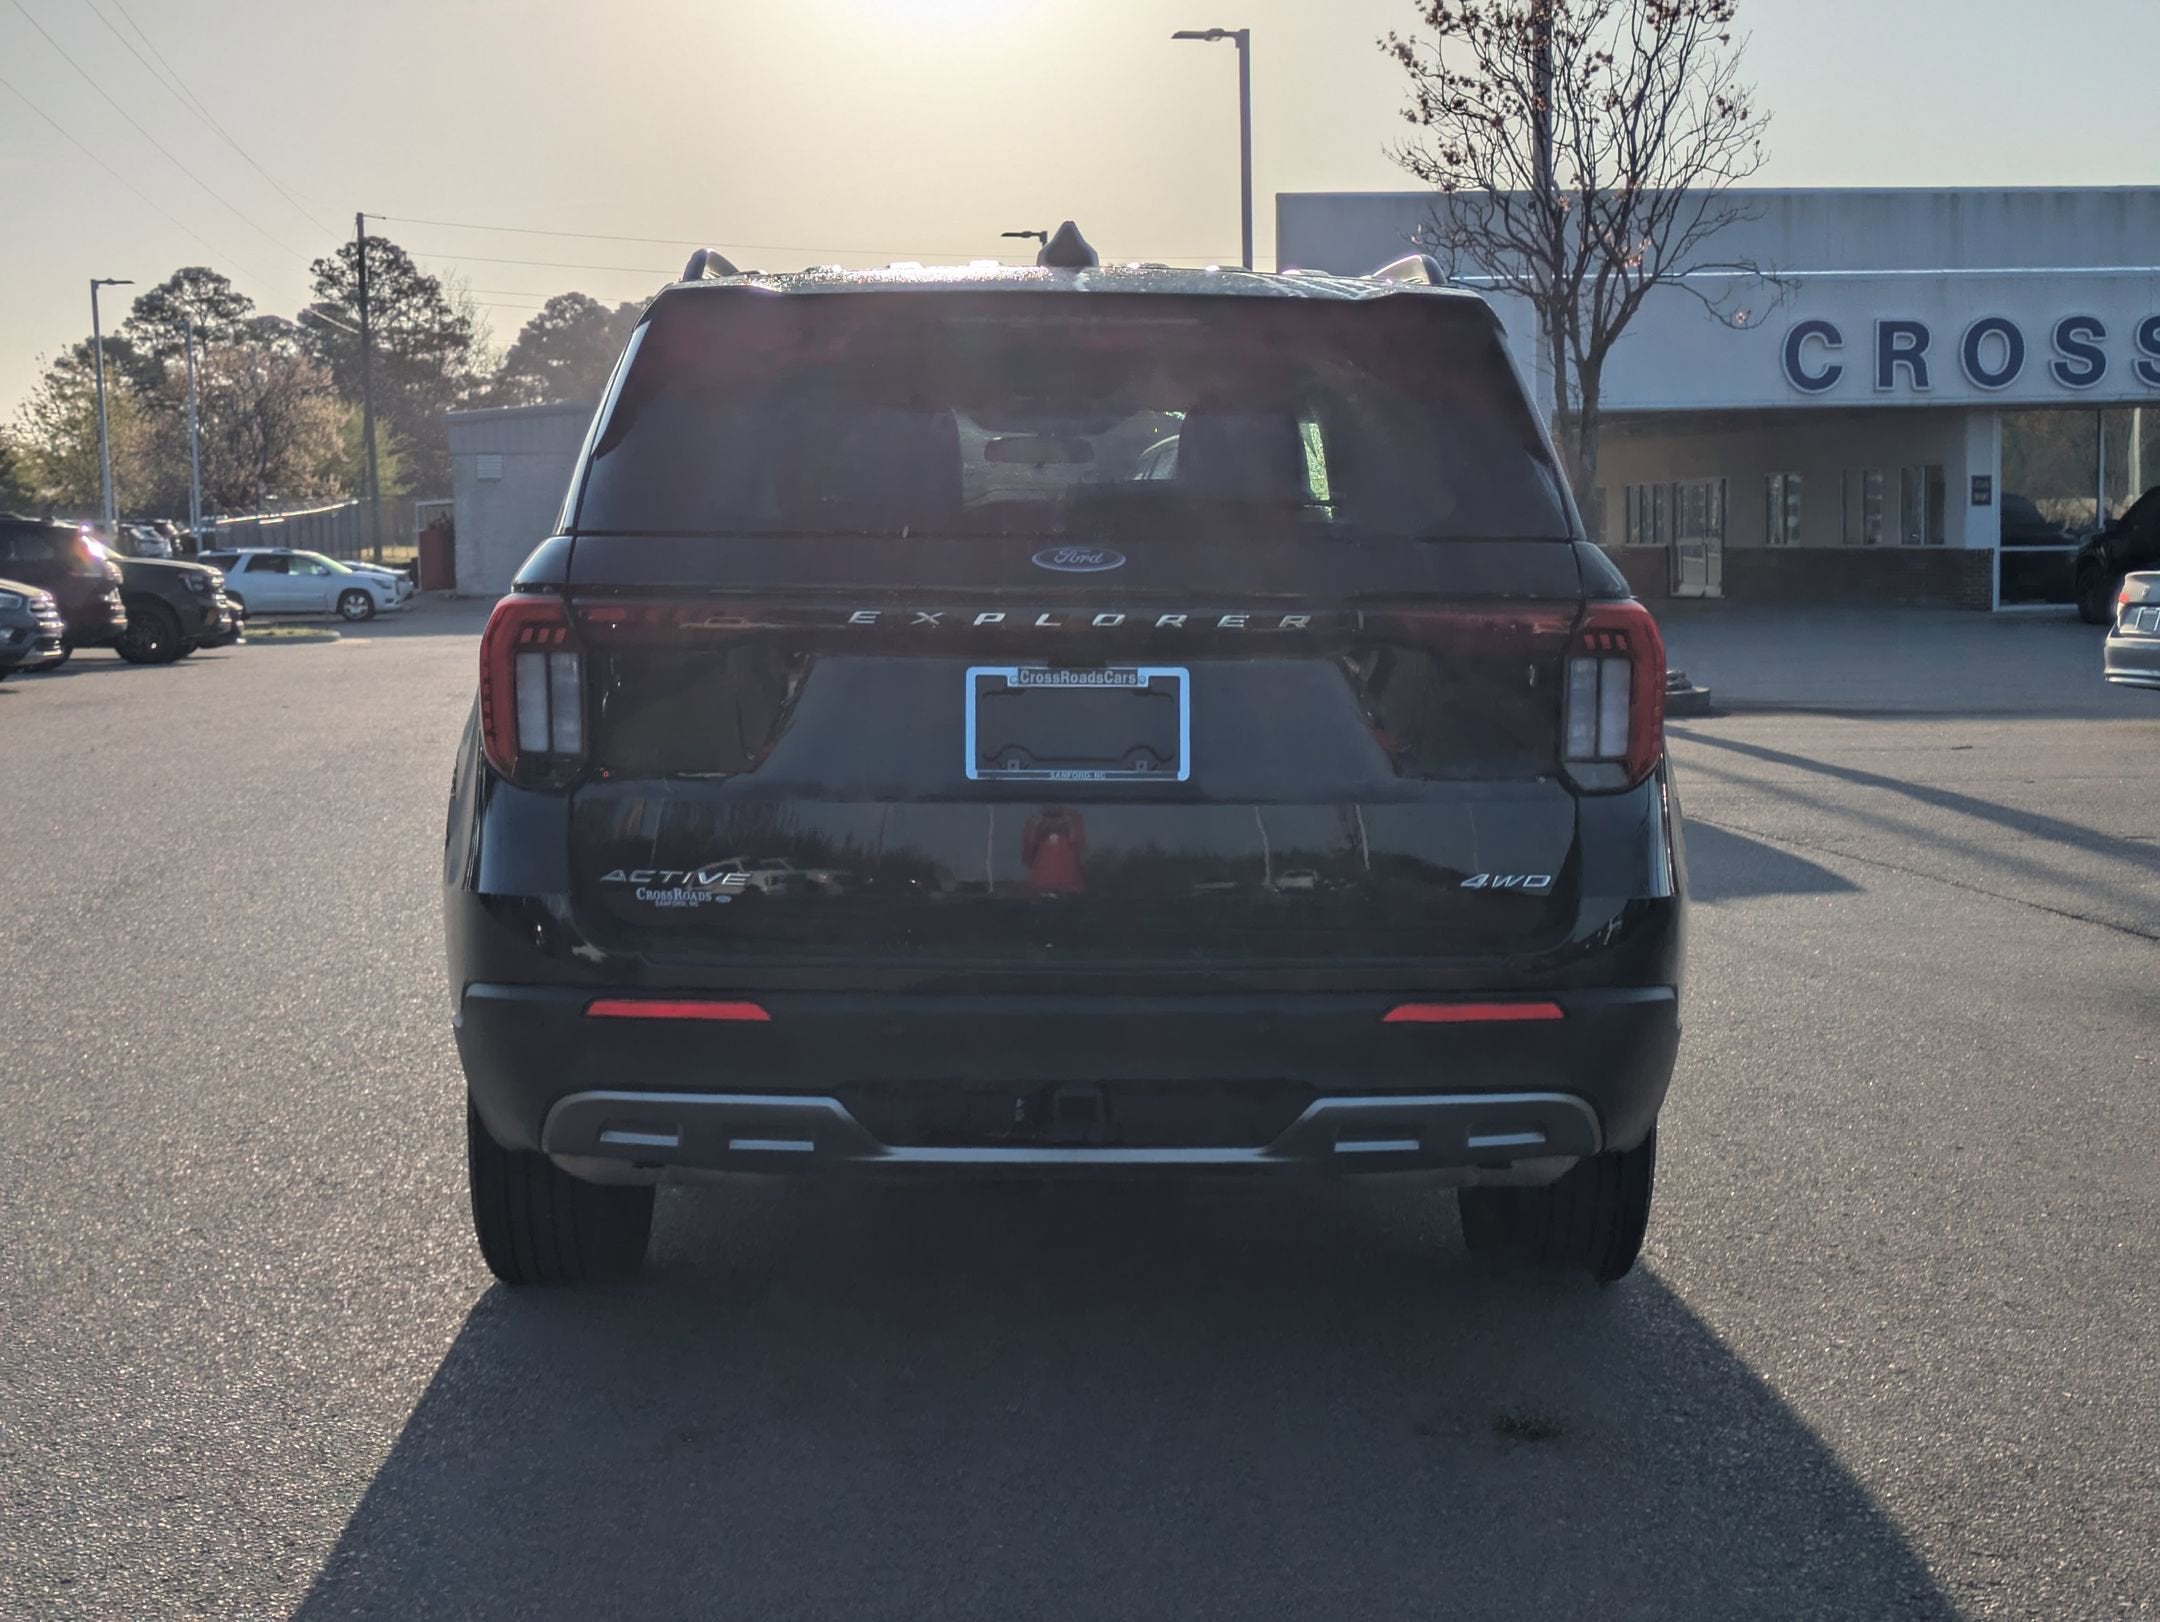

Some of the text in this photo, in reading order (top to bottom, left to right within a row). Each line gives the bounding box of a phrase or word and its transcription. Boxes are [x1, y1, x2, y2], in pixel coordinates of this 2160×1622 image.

[1054, 550, 1104, 564] Ford
[848, 610, 1311, 628] EXPLORER
[1020, 669, 1136, 684] CrossRoadsCars
[600, 869, 751, 886] ACTIVE
[1461, 873, 1551, 888] 4WD
